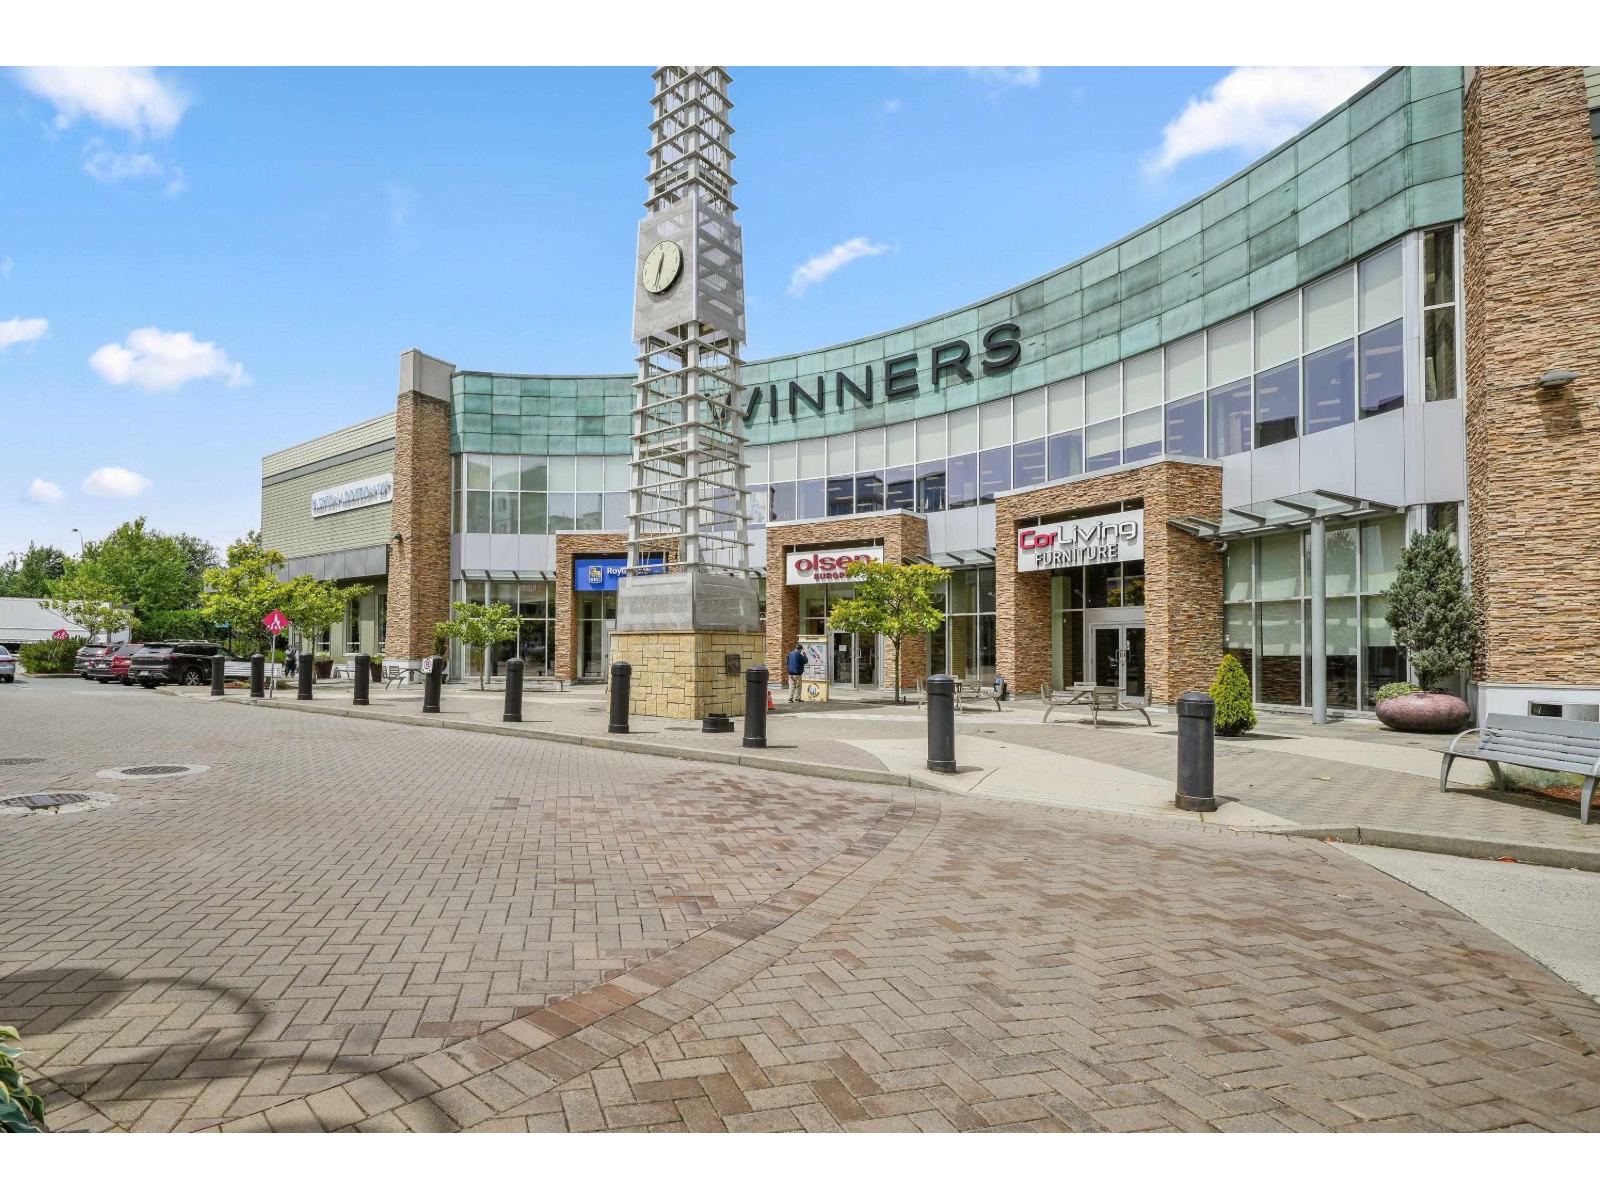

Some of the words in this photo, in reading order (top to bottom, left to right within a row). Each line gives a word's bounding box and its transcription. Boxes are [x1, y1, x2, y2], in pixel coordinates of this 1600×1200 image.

[704, 323, 1021, 422] WINNERS
[1019, 521, 1138, 550] CorLiving
[1035, 544, 1119, 566] FURNITURE
[607, 567, 629, 576] Roya
